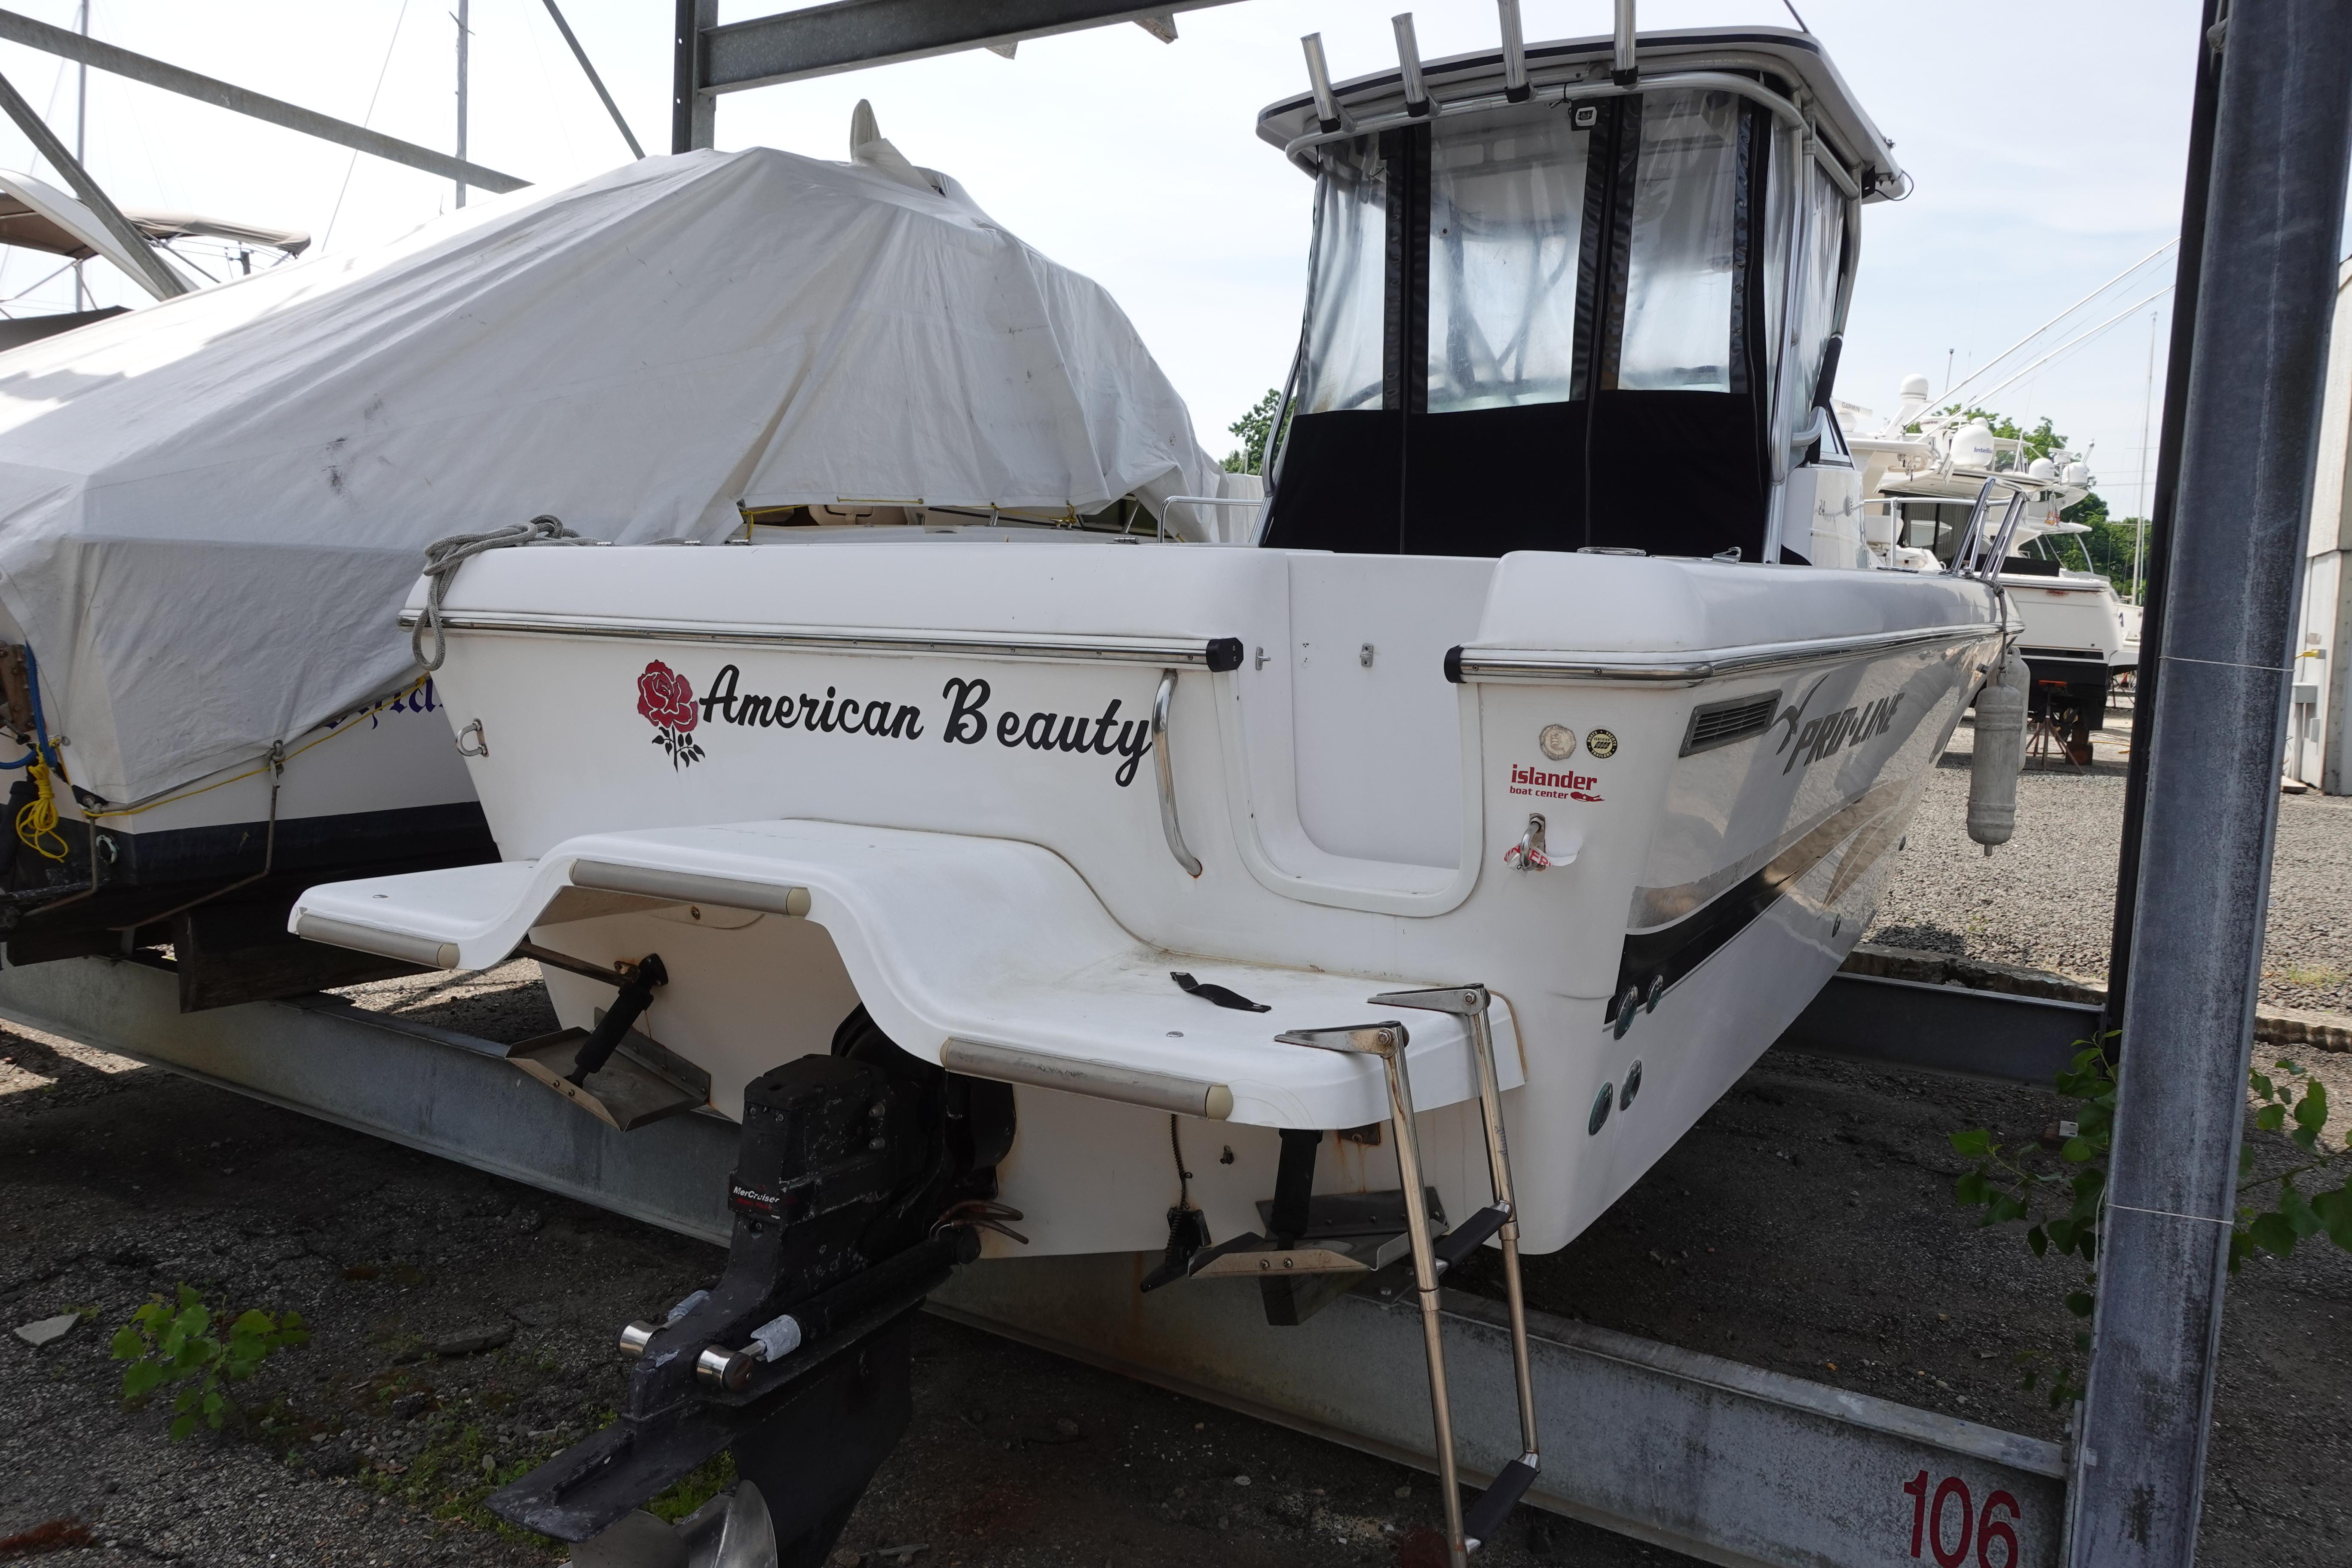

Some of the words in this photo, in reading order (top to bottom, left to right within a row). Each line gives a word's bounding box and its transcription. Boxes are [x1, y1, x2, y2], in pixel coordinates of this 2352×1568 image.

[1842, 401, 1860, 412] GARMIN
[698, 664, 924, 740] American
[942, 677, 1152, 787] Beauty
[1587, 731, 1598, 743] BOATS
[1606, 731, 1617, 746] YACHTS
[1591, 750, 1612, 758] TRAILERS
[1511, 764, 1597, 790] islander
[1510, 786, 1533, 796] boat
[1535, 790, 1569, 799] center
[733, 1186, 780, 1203] MerCruiser
[1904, 1470, 2021, 1568] 106
